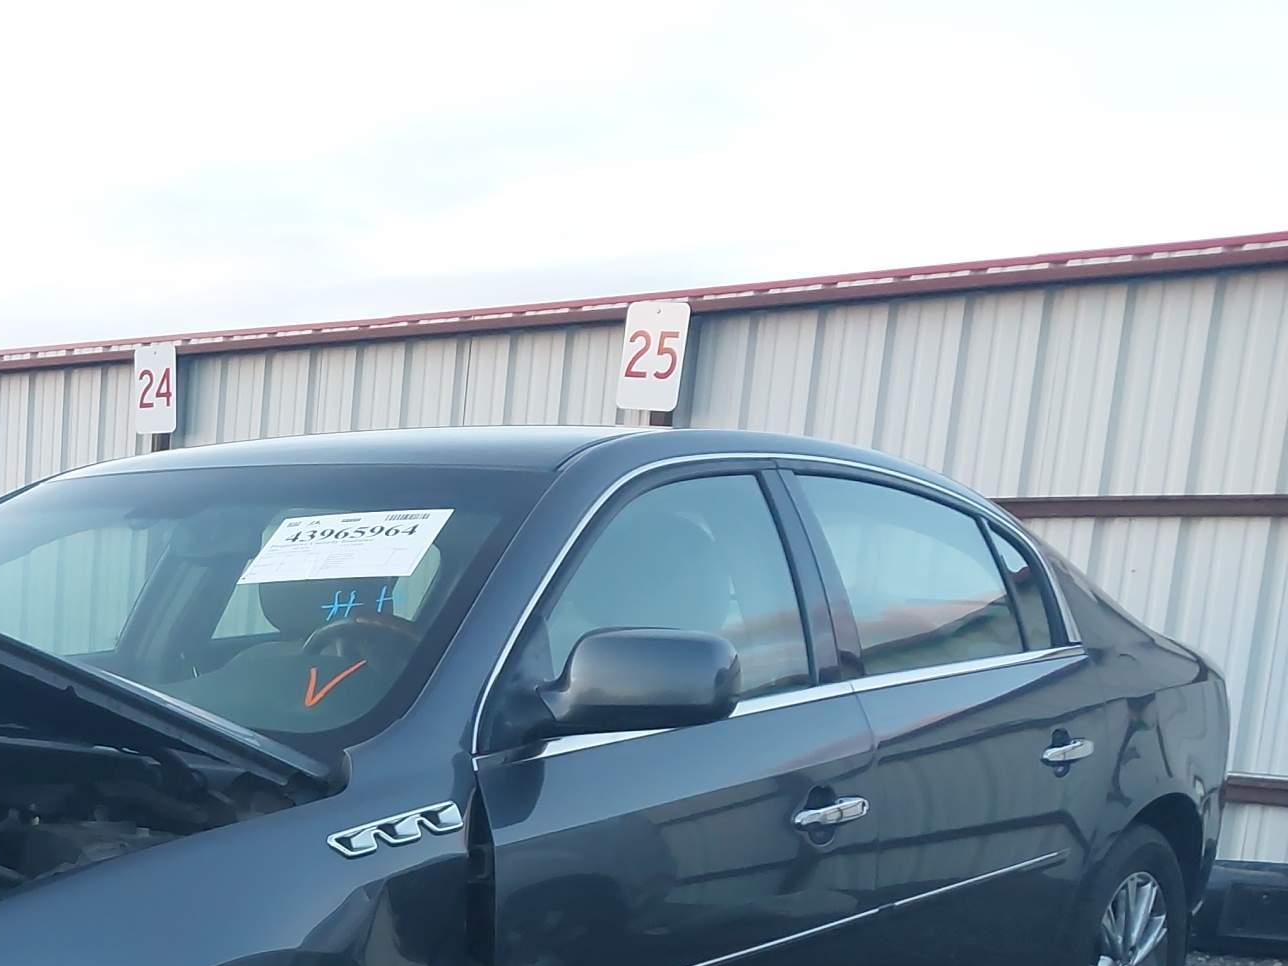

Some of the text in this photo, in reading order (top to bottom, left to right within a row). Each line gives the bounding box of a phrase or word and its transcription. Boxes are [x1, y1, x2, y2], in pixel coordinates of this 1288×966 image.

[624, 330, 680, 380] 25
[137, 368, 173, 409] 24
[285, 523, 420, 543] 43965964
